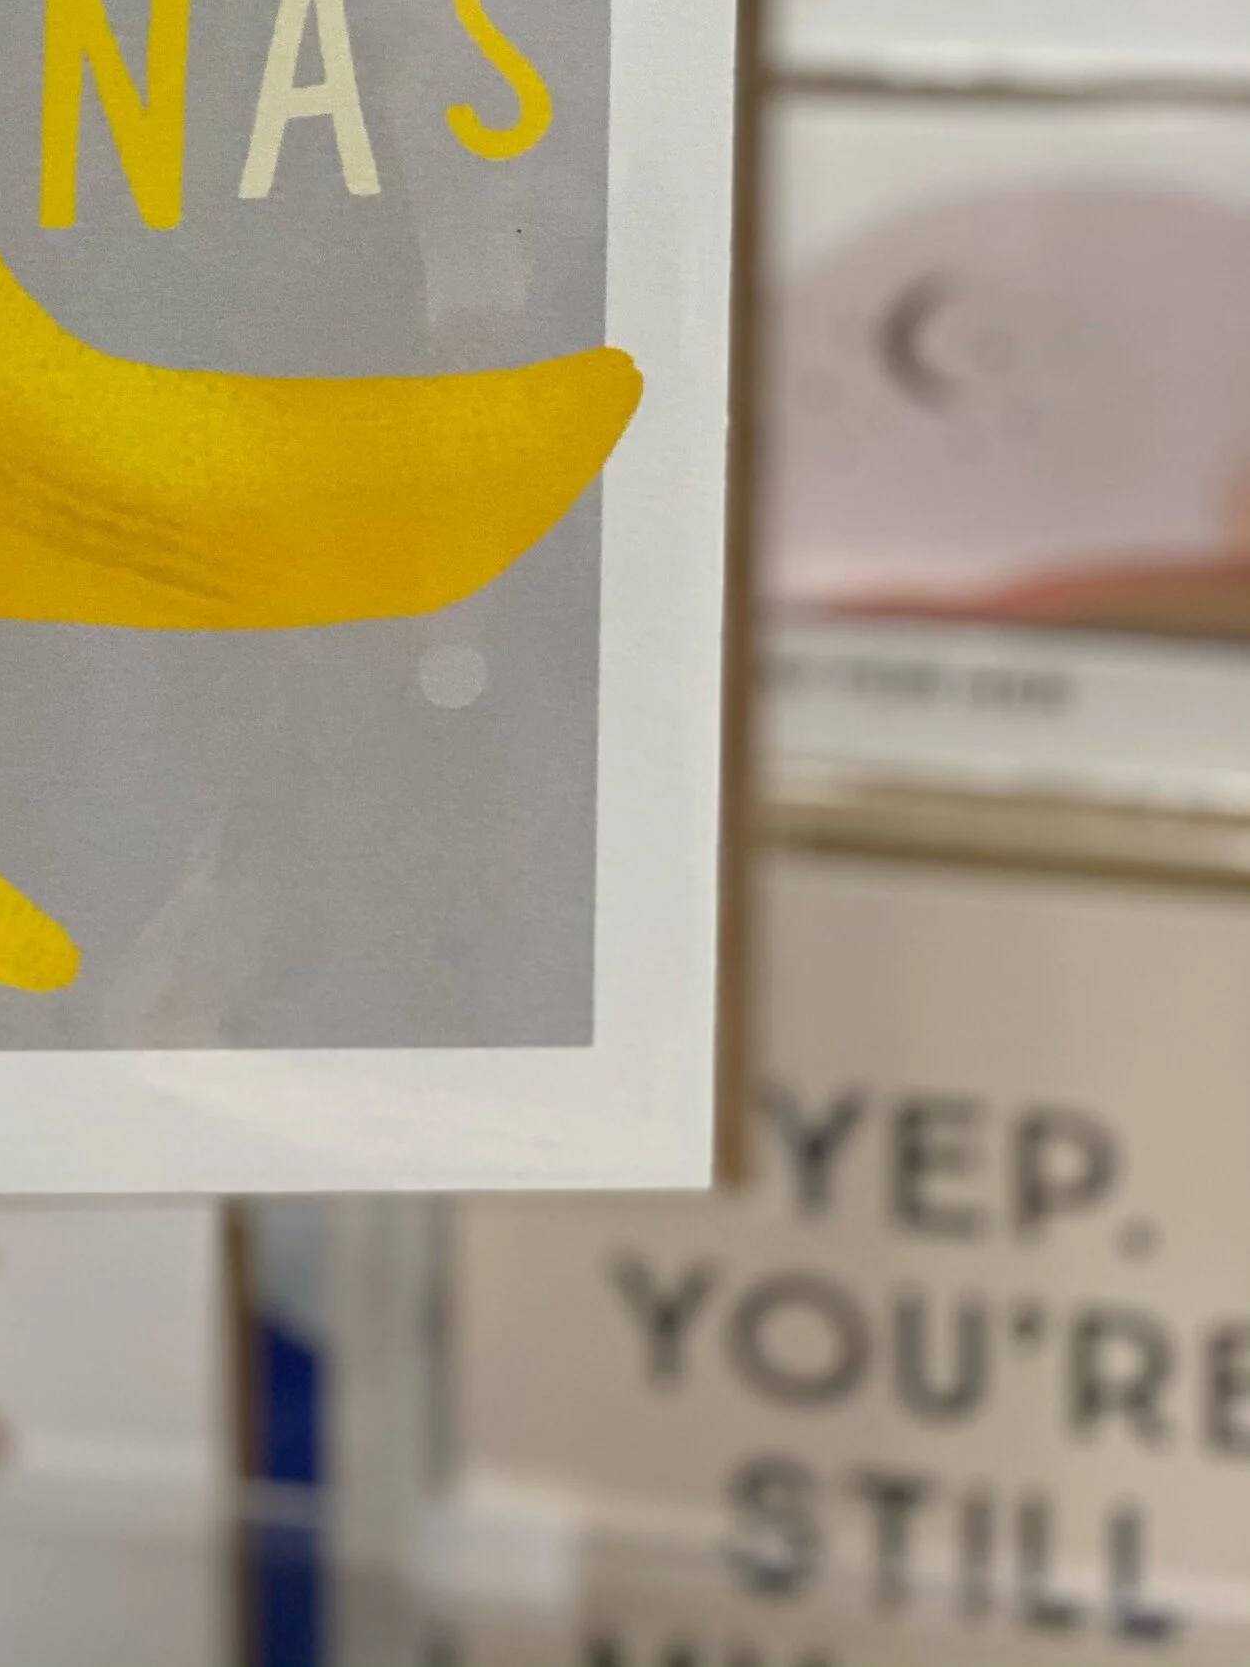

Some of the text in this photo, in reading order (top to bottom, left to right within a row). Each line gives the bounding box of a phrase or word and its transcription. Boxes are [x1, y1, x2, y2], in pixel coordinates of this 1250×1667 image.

[753, 1077, 1163, 1263] YEP.
[606, 1245, 1250, 1458] YOU'RE
[720, 1450, 1180, 1646] STILL
